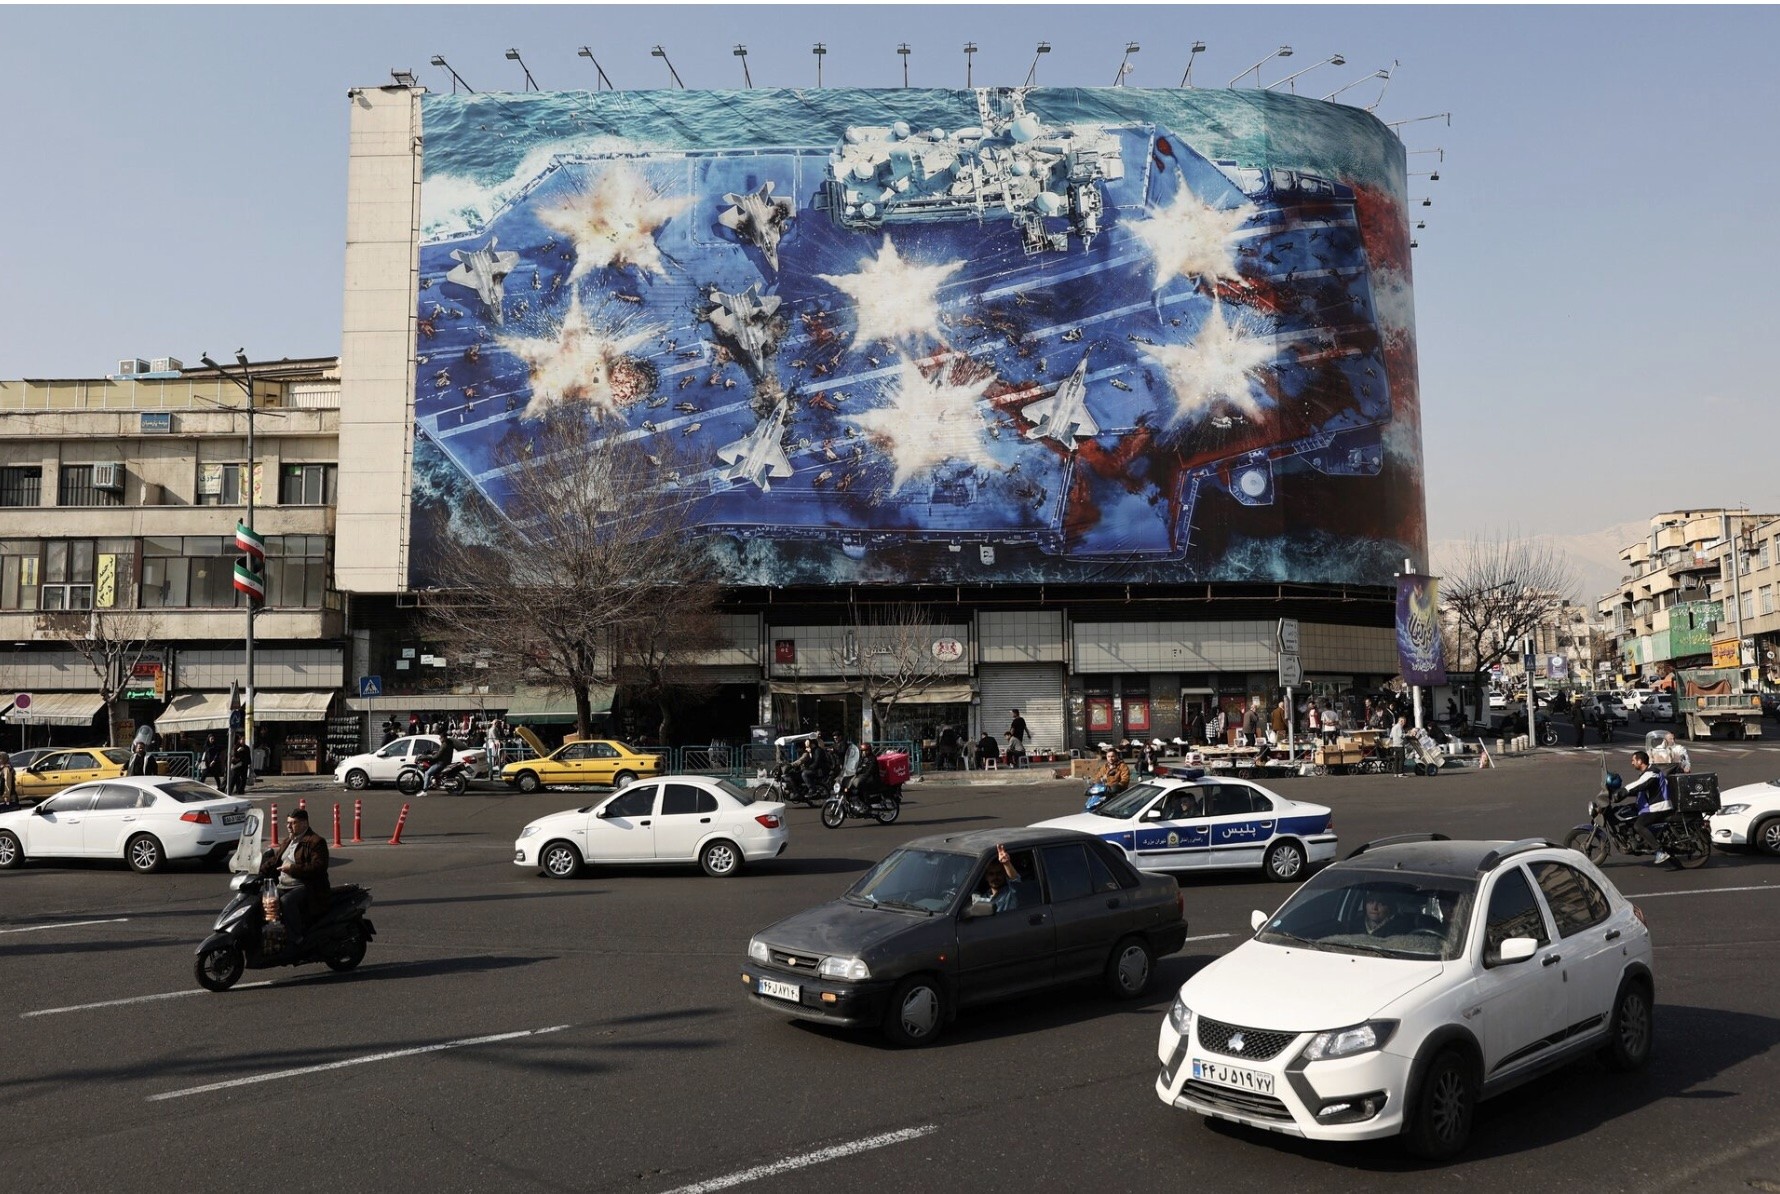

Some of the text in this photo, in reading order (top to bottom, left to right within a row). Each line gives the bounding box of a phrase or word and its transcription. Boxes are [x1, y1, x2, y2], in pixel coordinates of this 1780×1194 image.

[1222, 823, 1256, 839] پلیس
[1201, 1063, 1271, 1092] ۴۴ ل ۵۱۹ ۷۷
